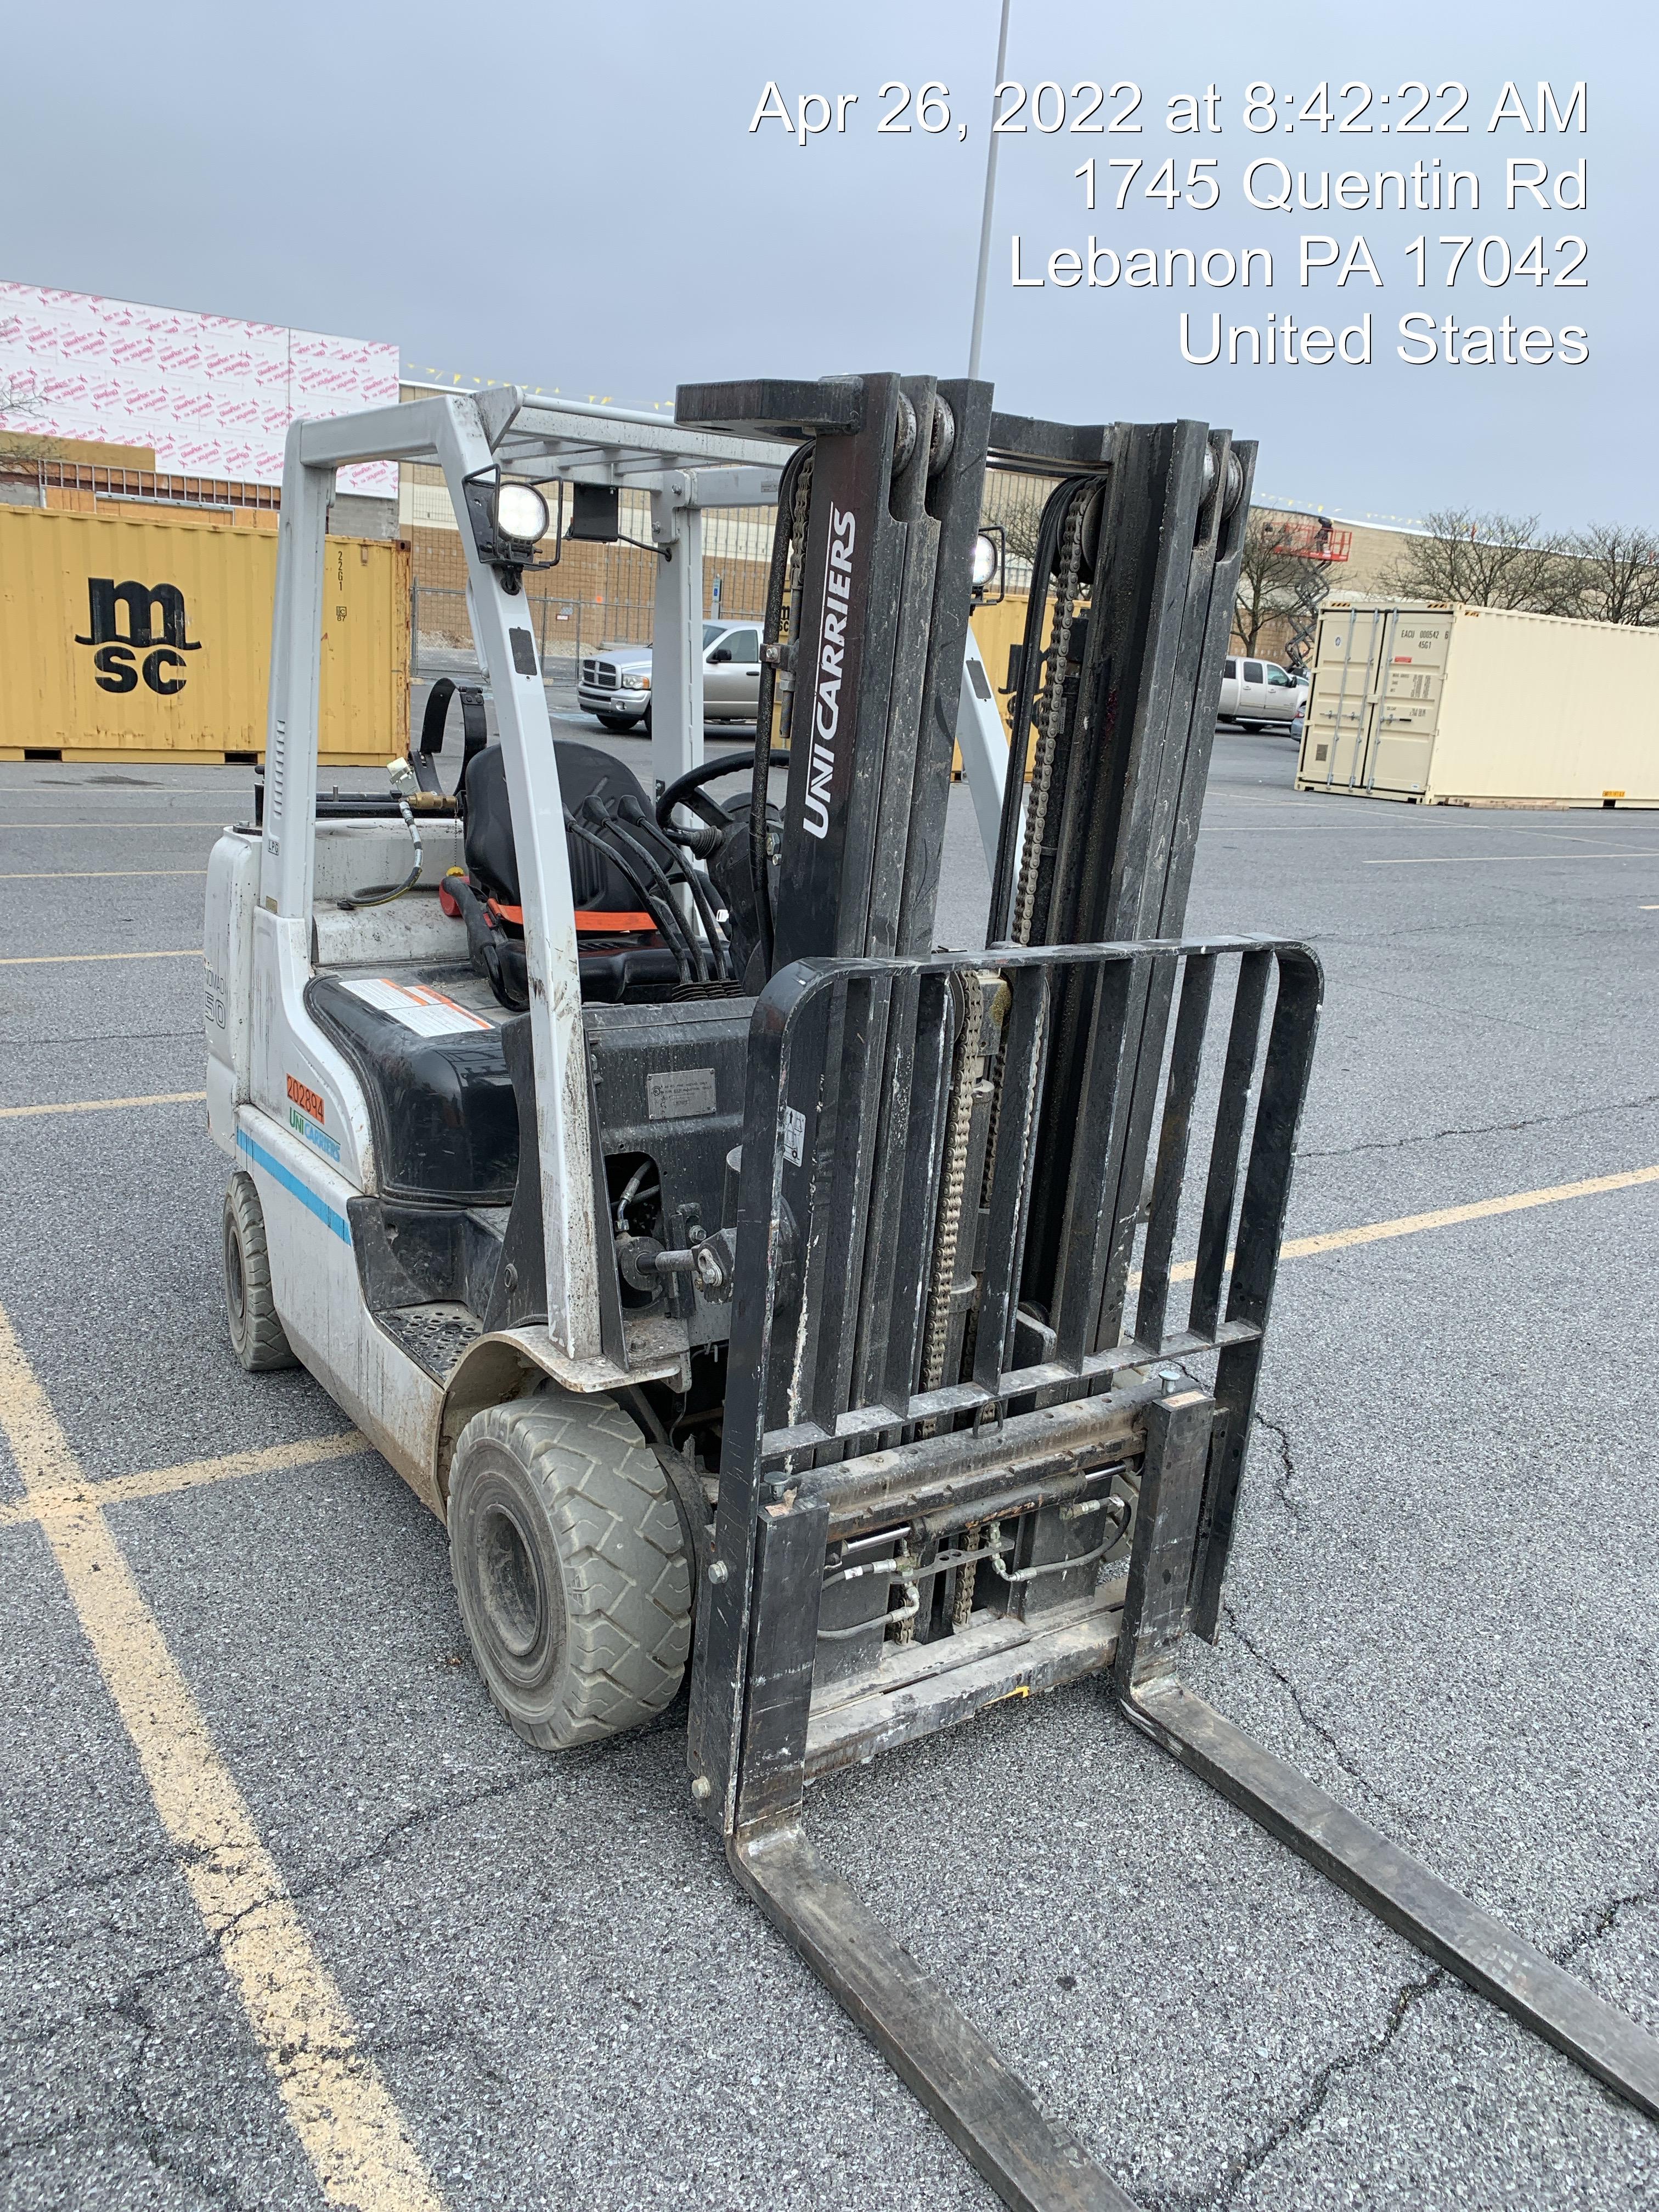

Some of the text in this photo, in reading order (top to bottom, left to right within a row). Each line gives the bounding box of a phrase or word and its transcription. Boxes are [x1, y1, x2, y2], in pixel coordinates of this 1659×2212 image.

[1401, 630, 1415, 638] EACU
[803, 506, 856, 839] UNICARRIERS
[268, 840, 279, 853] LPG
[204, 990, 226, 1030] 50
[287, 1075, 324, 1118] 202894
